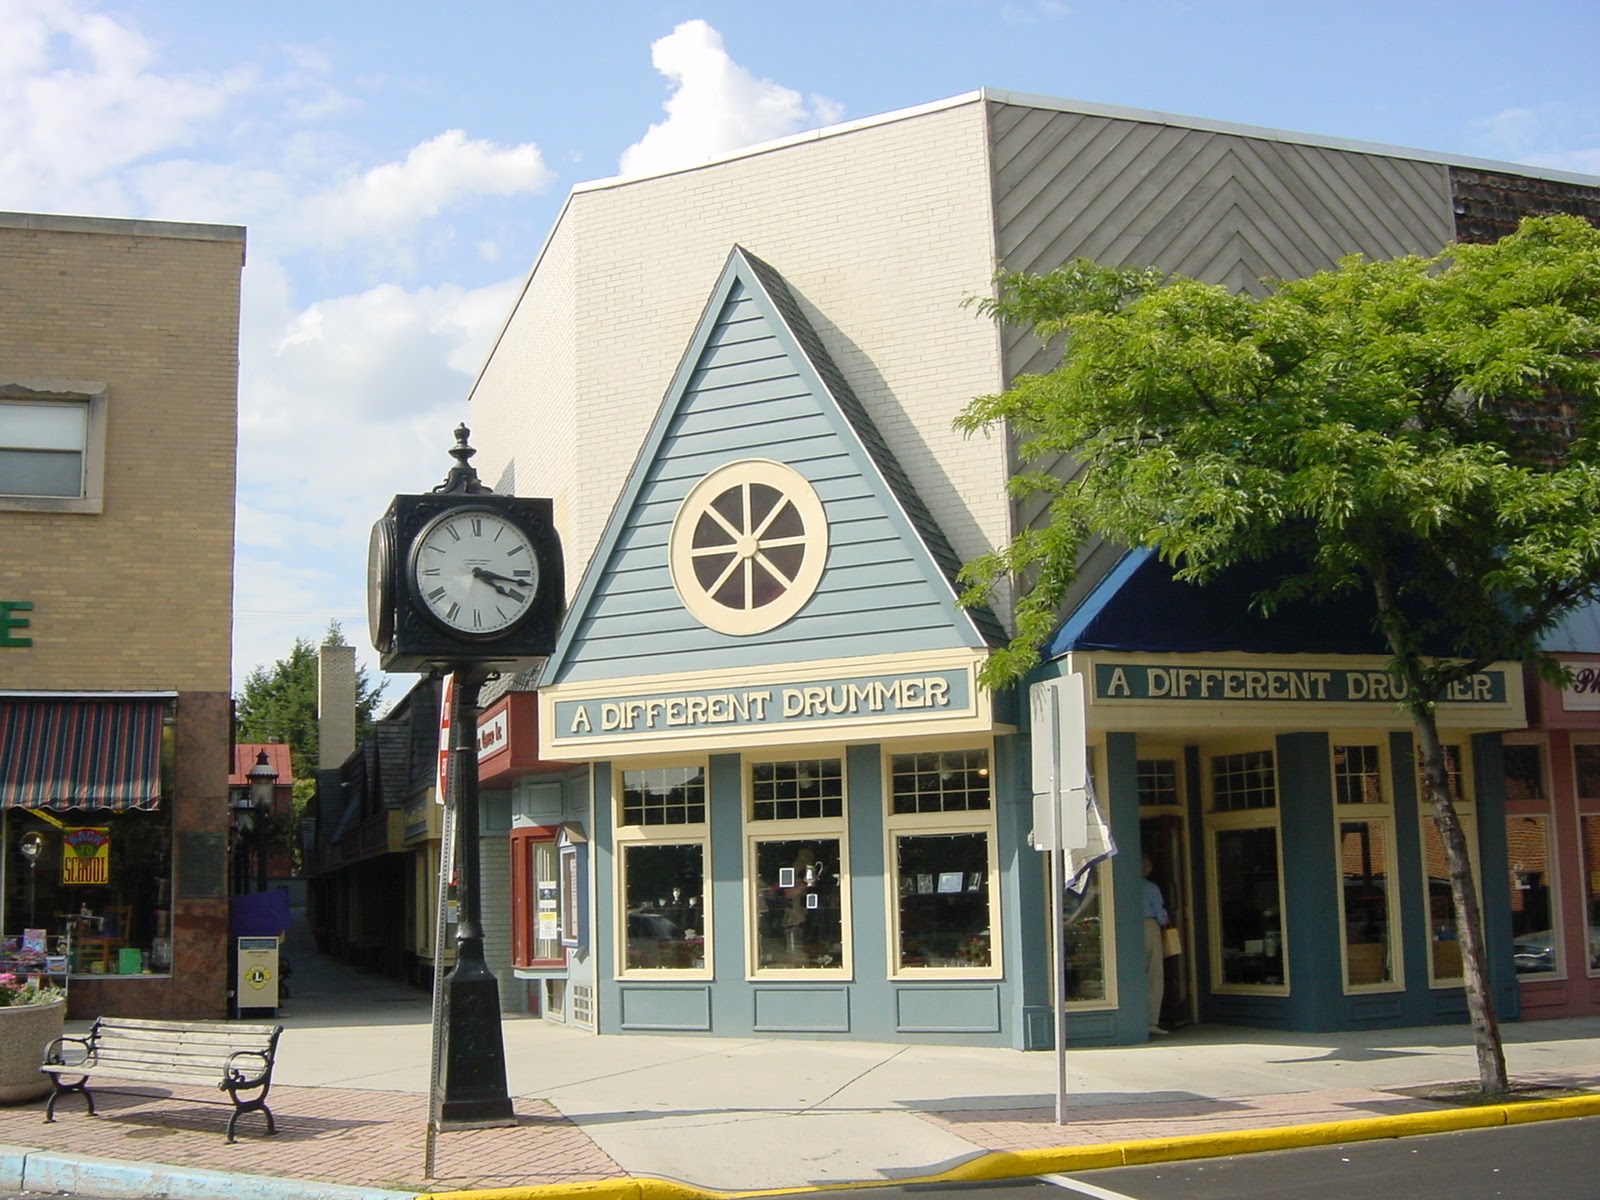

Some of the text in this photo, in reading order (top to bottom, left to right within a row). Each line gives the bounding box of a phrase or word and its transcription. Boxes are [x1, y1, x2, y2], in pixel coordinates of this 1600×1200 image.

[1107, 667, 1492, 701] A DIFFERENT DRUER
[571, 677, 949, 732] A DIFFERENT DRUMMER
[69, 831, 104, 846] BACK
[80, 845, 92, 854] TO
[65, 857, 107, 882] SCHOOL
[254, 971, 263, 982] L
